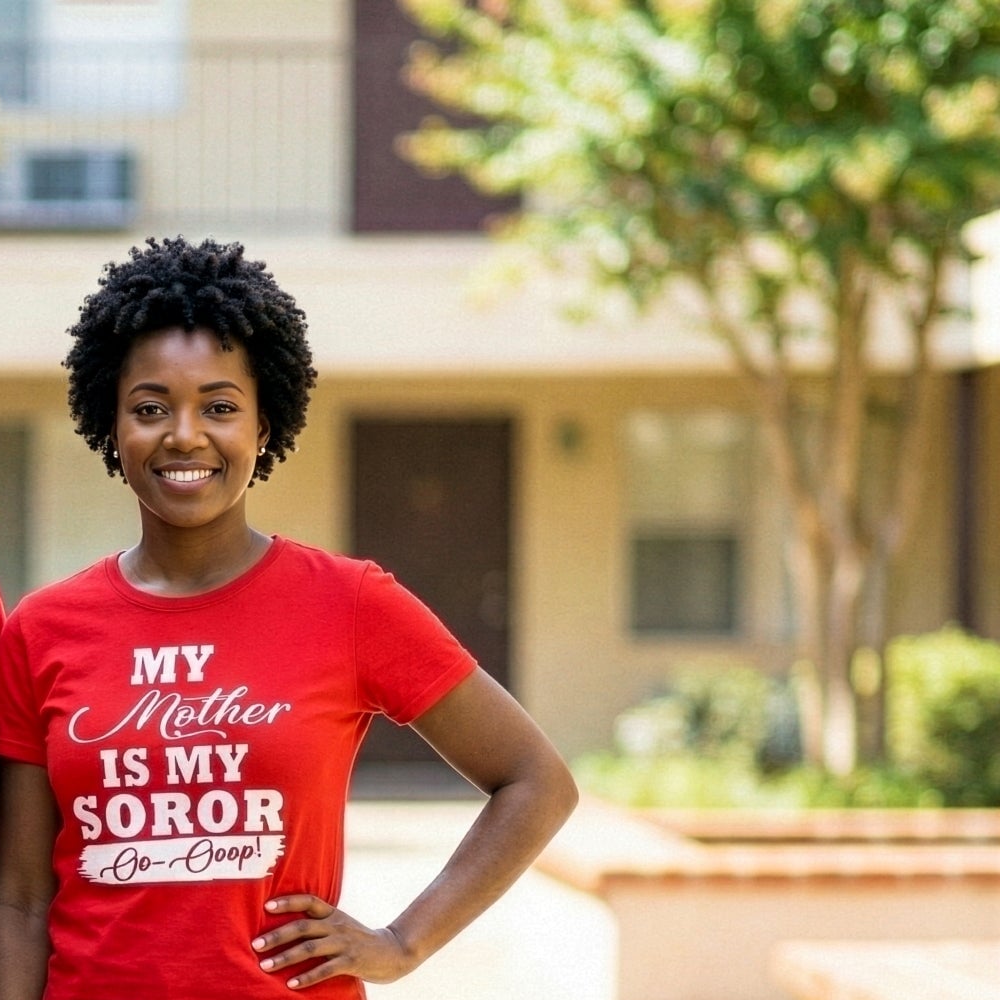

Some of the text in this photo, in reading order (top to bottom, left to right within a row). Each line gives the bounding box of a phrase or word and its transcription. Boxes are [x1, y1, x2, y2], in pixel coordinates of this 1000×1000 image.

[130, 644, 215, 686] MY
[68, 685, 291, 743] Mother
[99, 743, 249, 788] IS MY
[73, 789, 284, 840] SOROR
